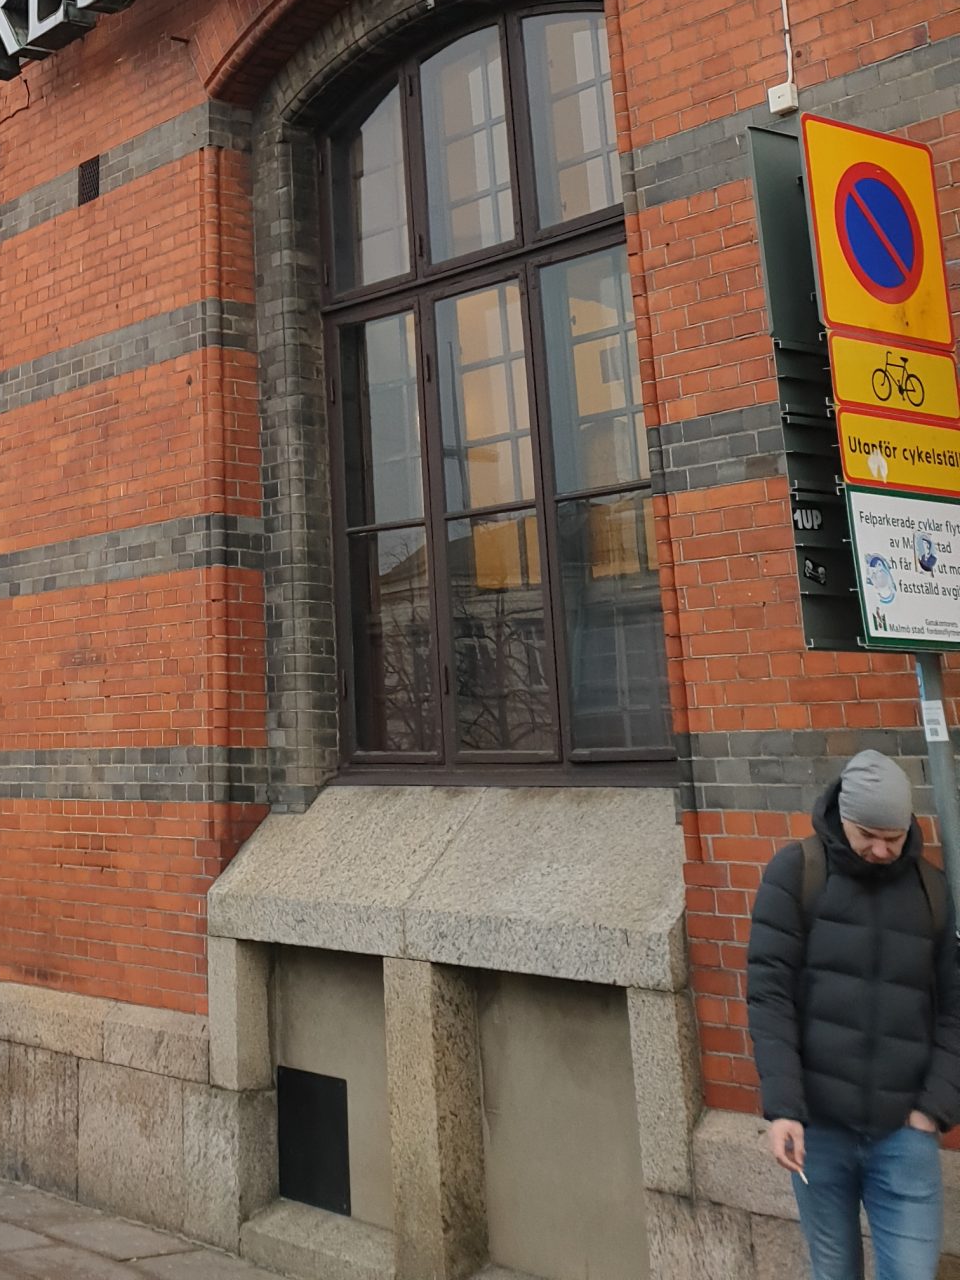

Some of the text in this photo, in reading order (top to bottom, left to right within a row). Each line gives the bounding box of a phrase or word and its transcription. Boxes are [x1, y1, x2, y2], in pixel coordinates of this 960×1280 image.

[902, 445, 960, 468] cykelstäl
[793, 508, 822, 530] 1UP
[859, 510, 916, 530] Felparkerade
[889, 538, 900, 549] av
[899, 556, 912, 571] får
[898, 579, 940, 596] fastställd
